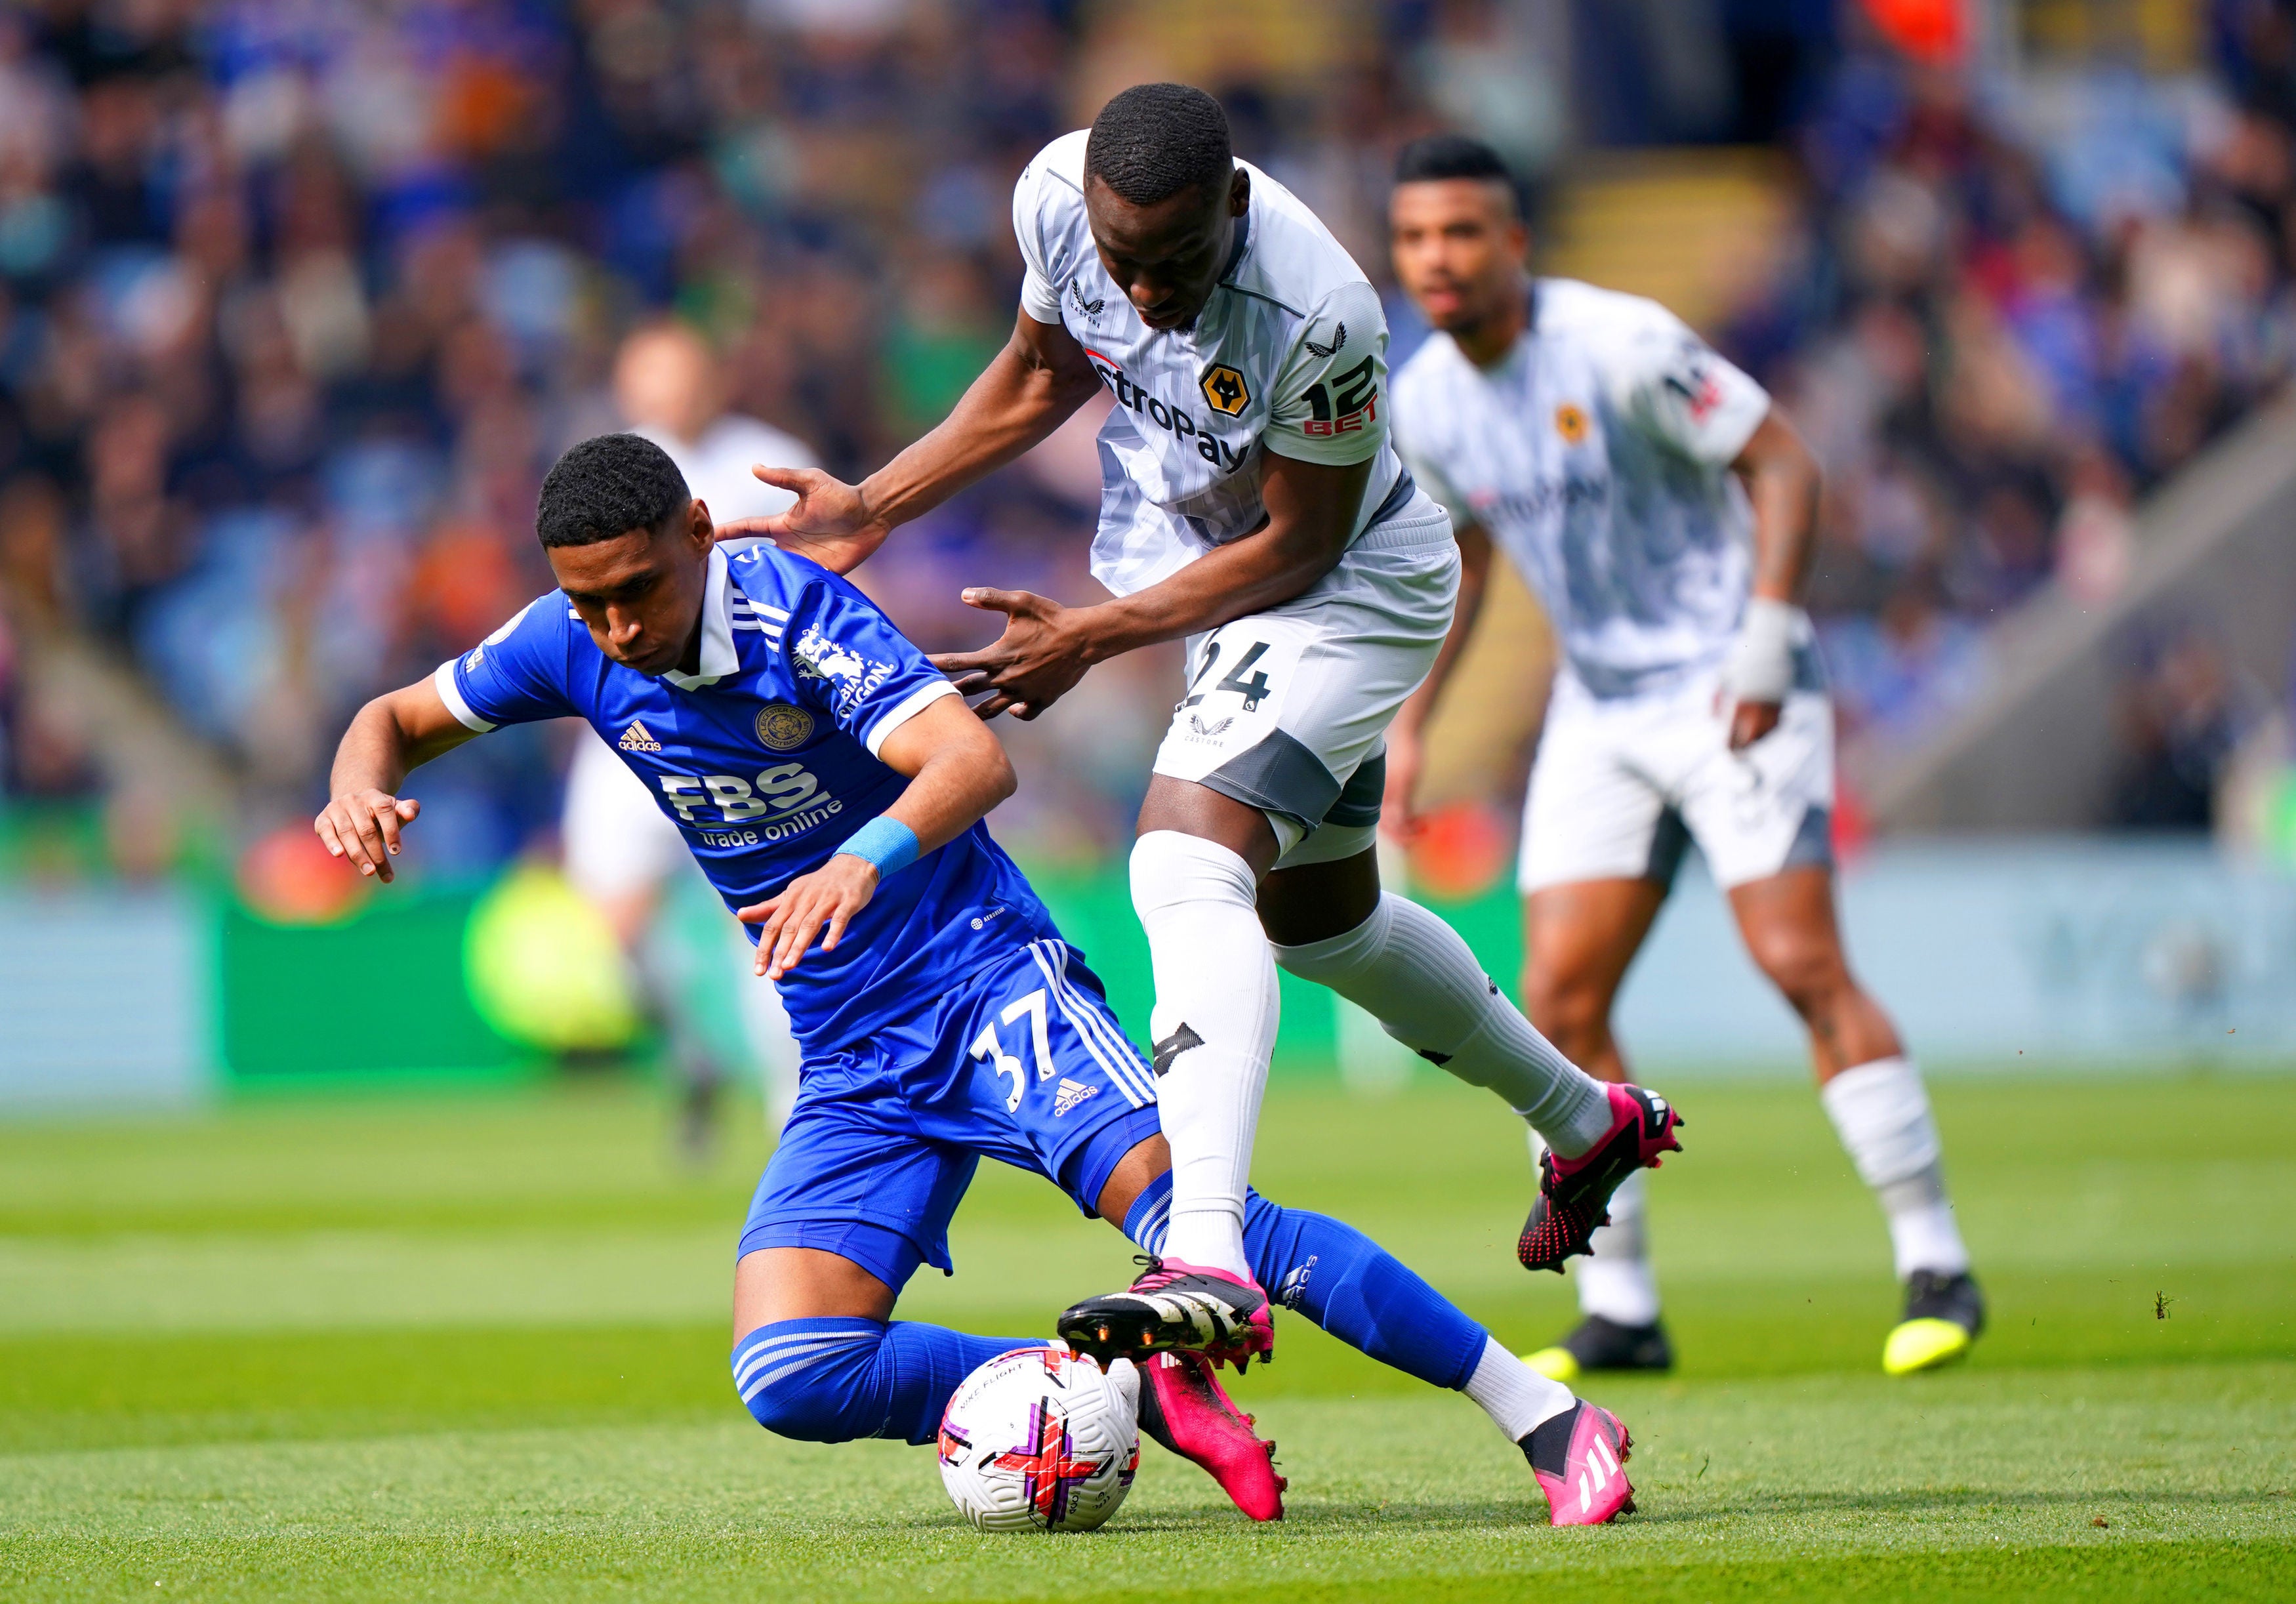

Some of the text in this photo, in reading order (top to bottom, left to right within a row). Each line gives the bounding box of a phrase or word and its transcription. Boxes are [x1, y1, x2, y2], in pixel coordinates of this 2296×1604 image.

[1070, 302, 1101, 329] CASTORE
[1300, 354, 1378, 421] 12
[1303, 392, 1378, 436] BET
[840, 676, 862, 703] BIA
[1175, 640, 1271, 713] 24
[762, 708, 806, 731] LEICESTER CITY
[618, 739, 662, 752] adidas
[765, 733, 802, 745] FOOTBALL
[1183, 735, 1225, 748] CASTORE
[658, 762, 819, 822] FBS
[699, 799, 844, 848] trade online
[968, 987, 1057, 1115] 37
[1054, 1085, 1099, 1118] adidas
[960, 1363, 1023, 1412] NIKE FLIGHT
